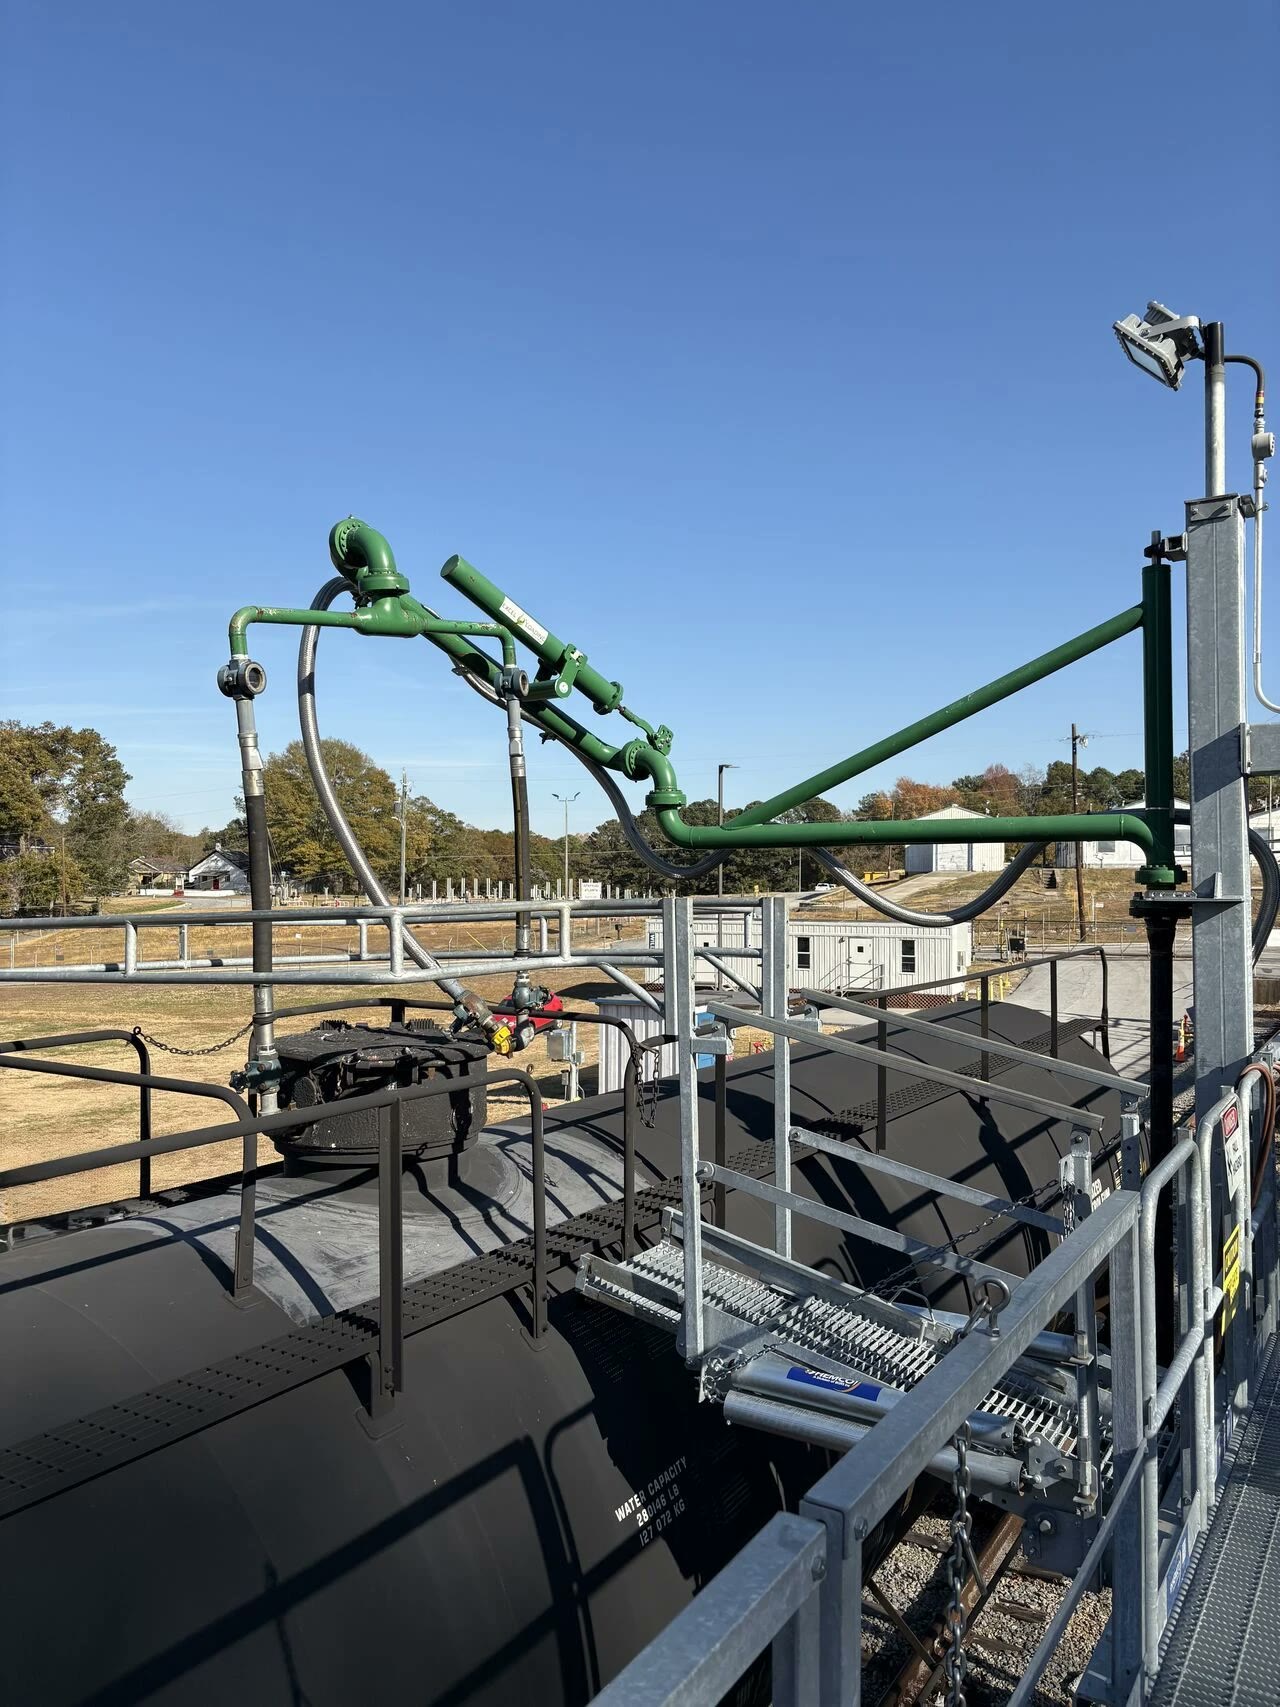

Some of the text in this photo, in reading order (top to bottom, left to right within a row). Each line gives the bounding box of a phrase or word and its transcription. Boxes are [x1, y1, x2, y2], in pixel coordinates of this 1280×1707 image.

[614, 1456, 687, 1522] WATER CAPACITY
[636, 1484, 680, 1527] 280146 LB
[640, 1498, 686, 1547] 127 072 KG
